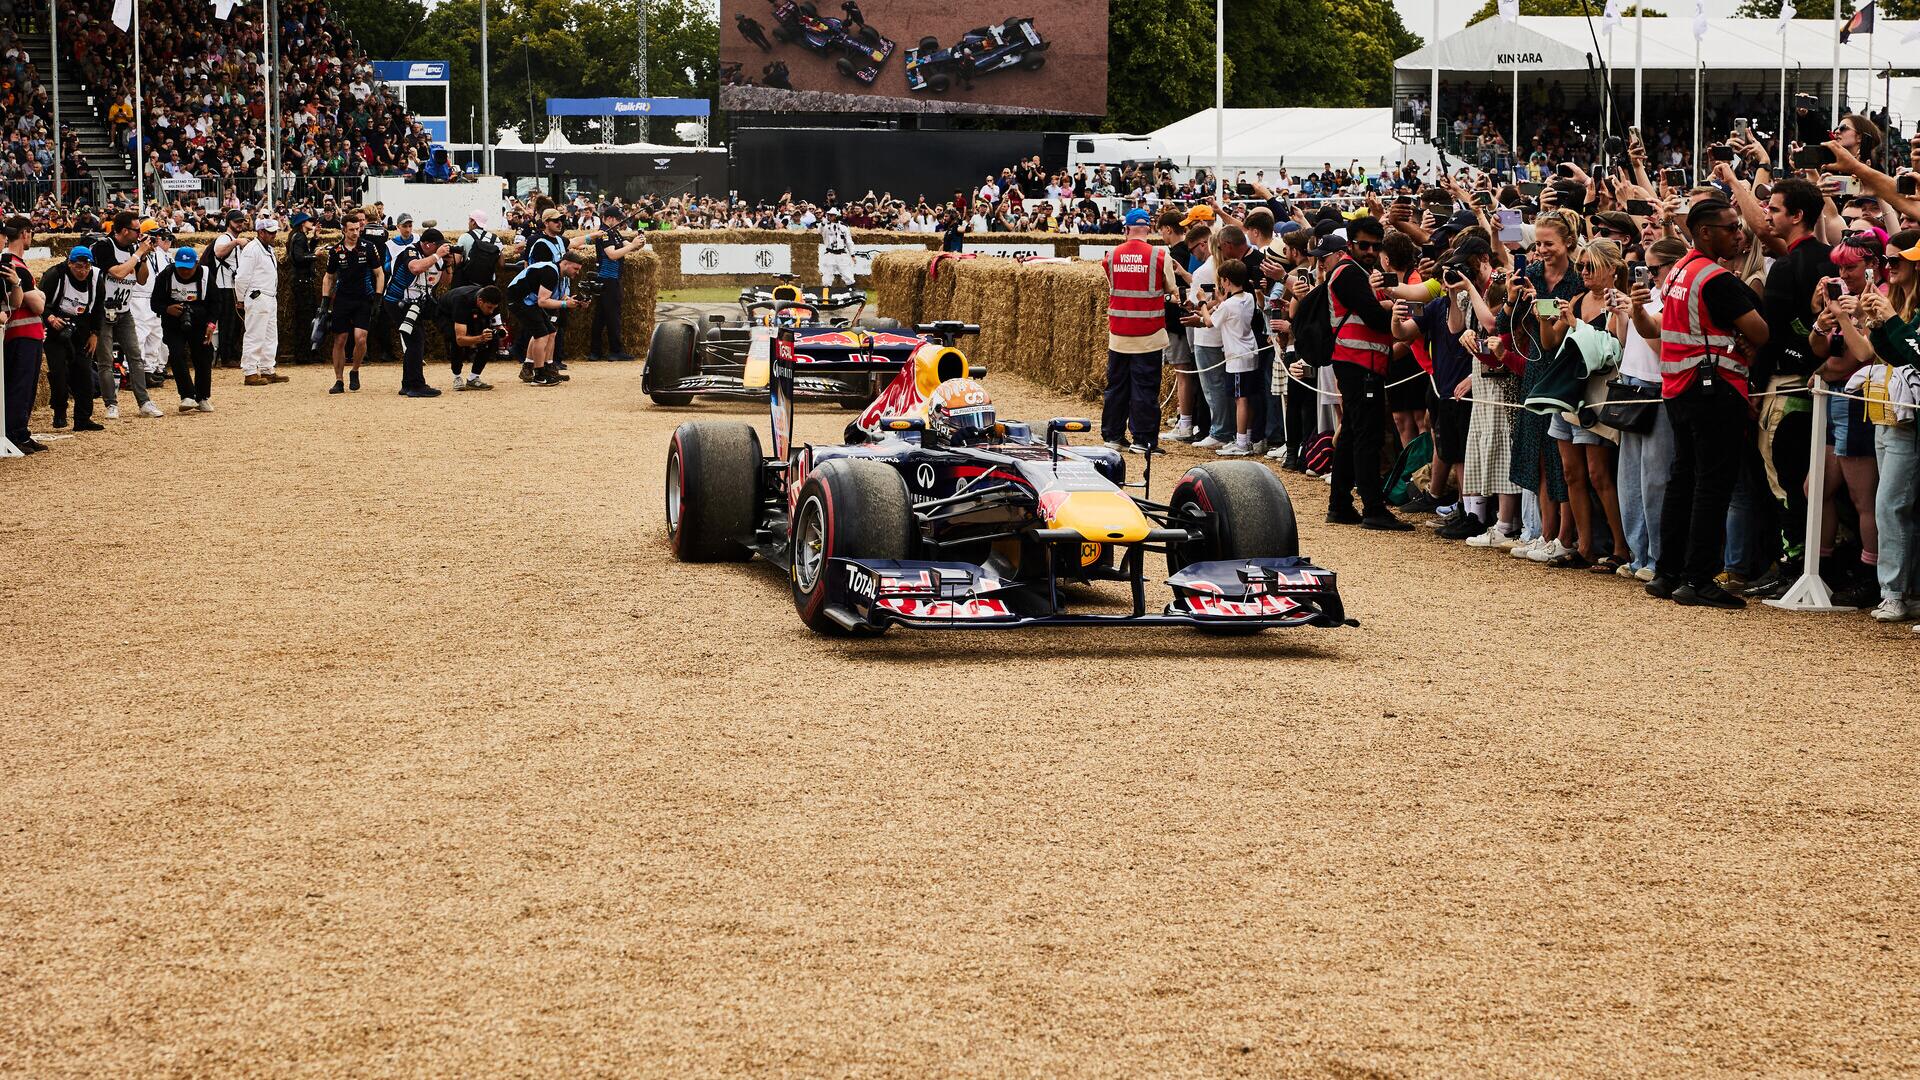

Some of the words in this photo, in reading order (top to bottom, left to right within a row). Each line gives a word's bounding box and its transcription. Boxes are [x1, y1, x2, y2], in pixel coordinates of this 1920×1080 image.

[1120, 253, 1143, 264] VISITOR
[1113, 263, 1149, 273] MANAGEMENT
[910, 493, 942, 503] INFINIT
[845, 564, 877, 600] TOTAL
